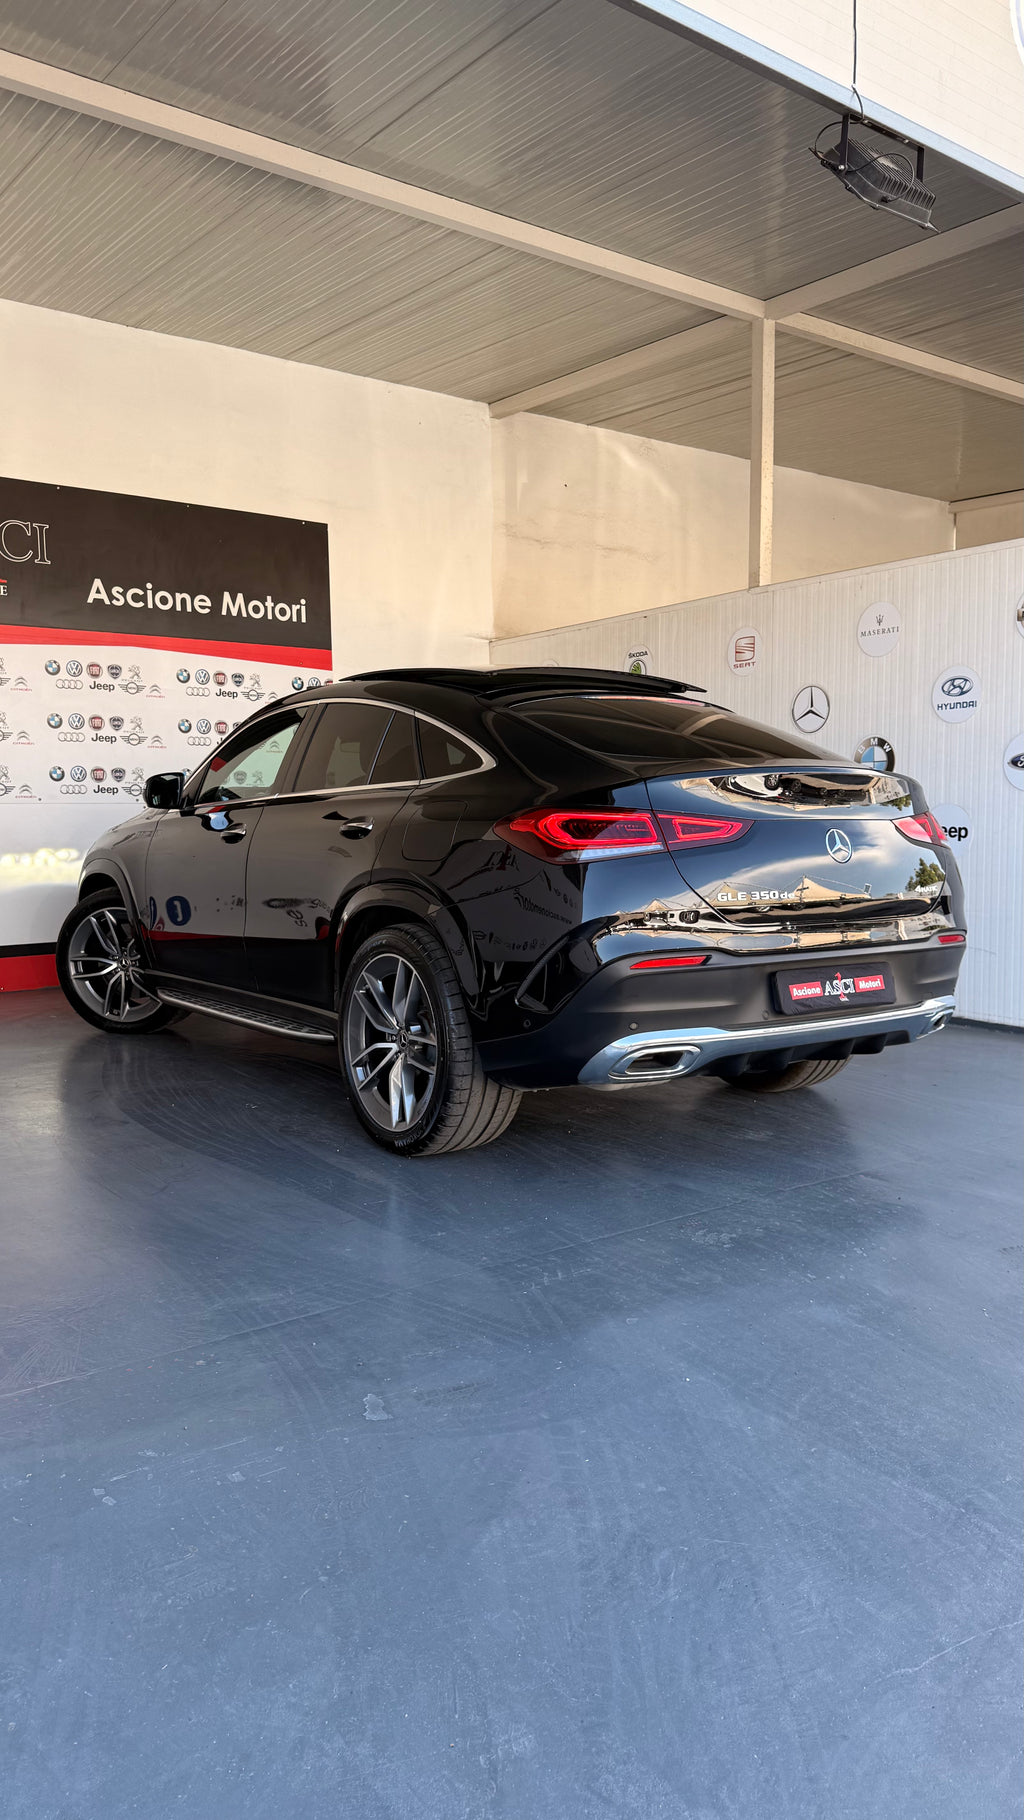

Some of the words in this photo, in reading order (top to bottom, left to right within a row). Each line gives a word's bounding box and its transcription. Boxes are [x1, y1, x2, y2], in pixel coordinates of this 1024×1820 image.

[87, 578, 212, 615] Ascione
[221, 591, 307, 623] Motori
[860, 626, 900, 638] MASERATI
[733, 661, 756, 669] SEAT
[89, 681, 116, 692] Jeep
[215, 688, 238, 699] Jeep
[937, 700, 977, 711] HYUNDAI
[91, 733, 117, 744] Jeep
[93, 785, 119, 796] Jeep
[717, 891, 747, 902] GLE
[793, 986, 821, 997] Ascione
[824, 978, 856, 996] ASCI
[859, 978, 881, 990] Motori
